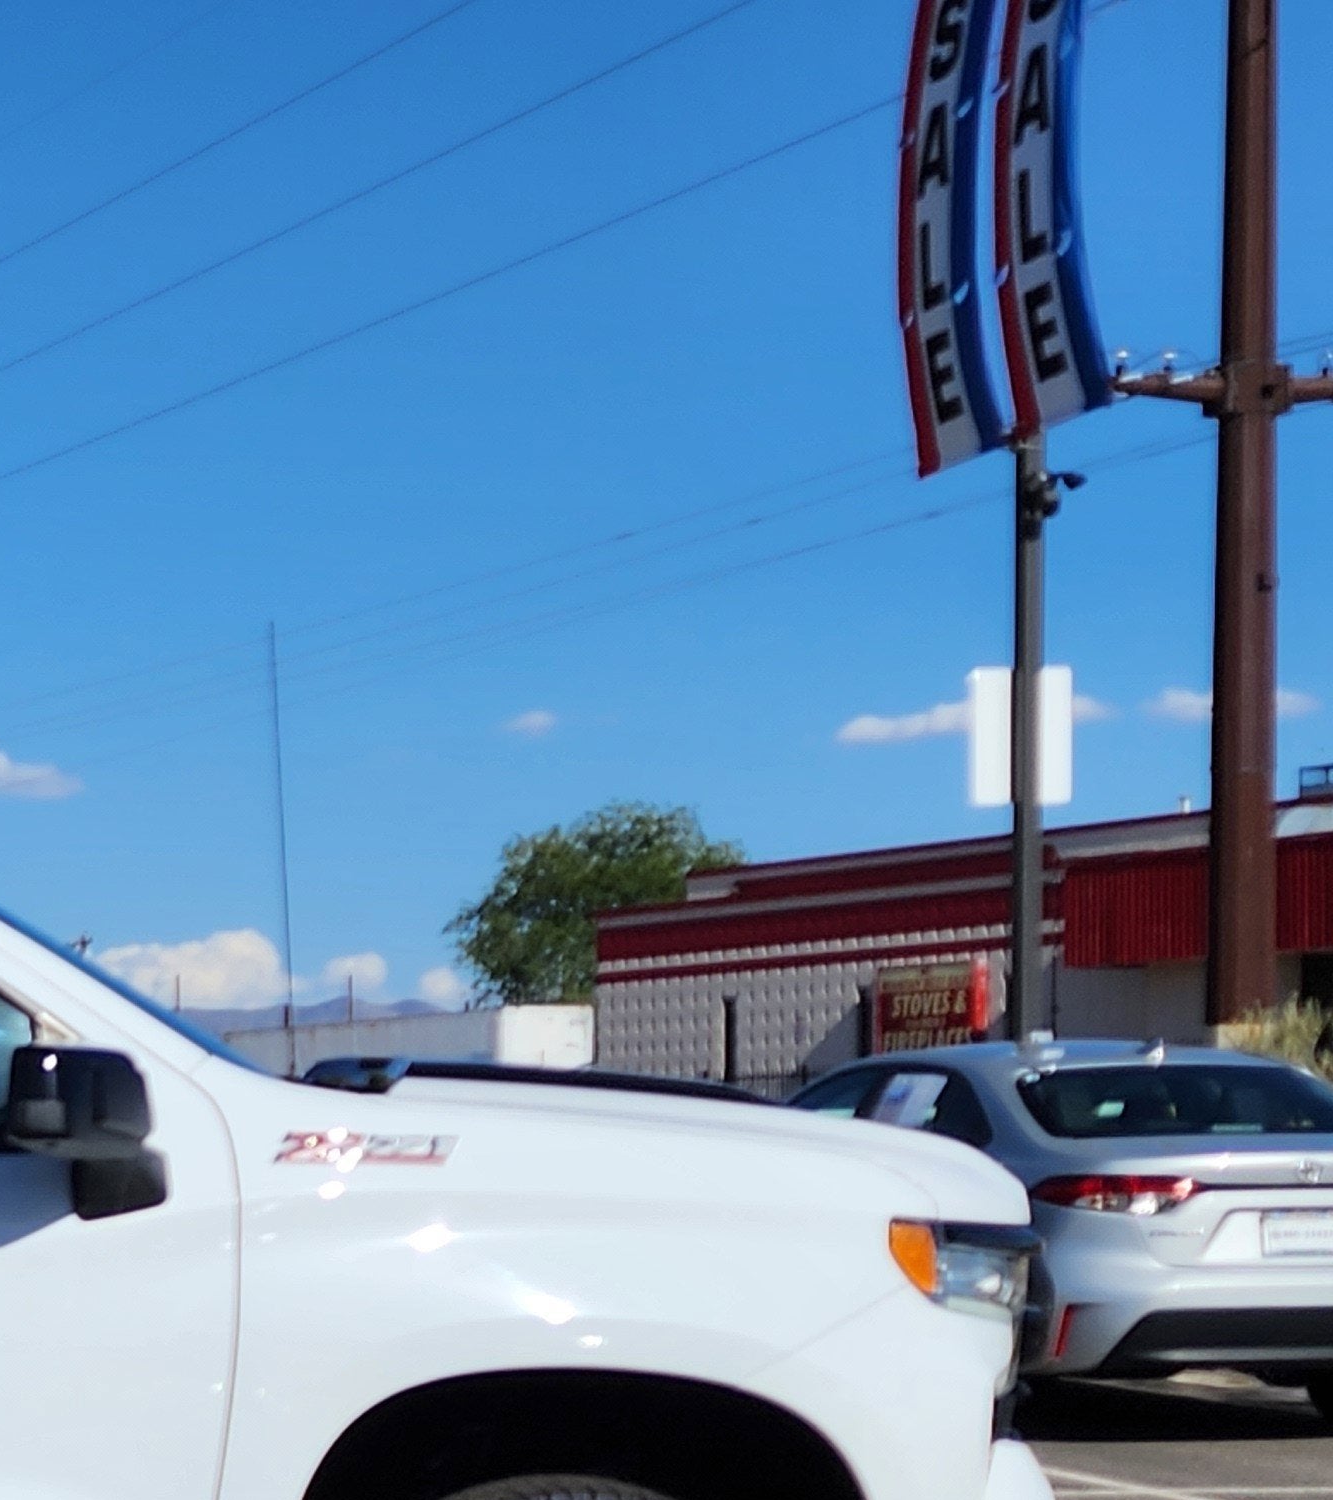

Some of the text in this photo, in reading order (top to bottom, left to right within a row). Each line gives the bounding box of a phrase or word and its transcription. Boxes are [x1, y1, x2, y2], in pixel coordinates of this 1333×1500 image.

[917, 0, 966, 424] SALE
[1014, 0, 1070, 383] ALE
[892, 990, 967, 1018] STOVES &
